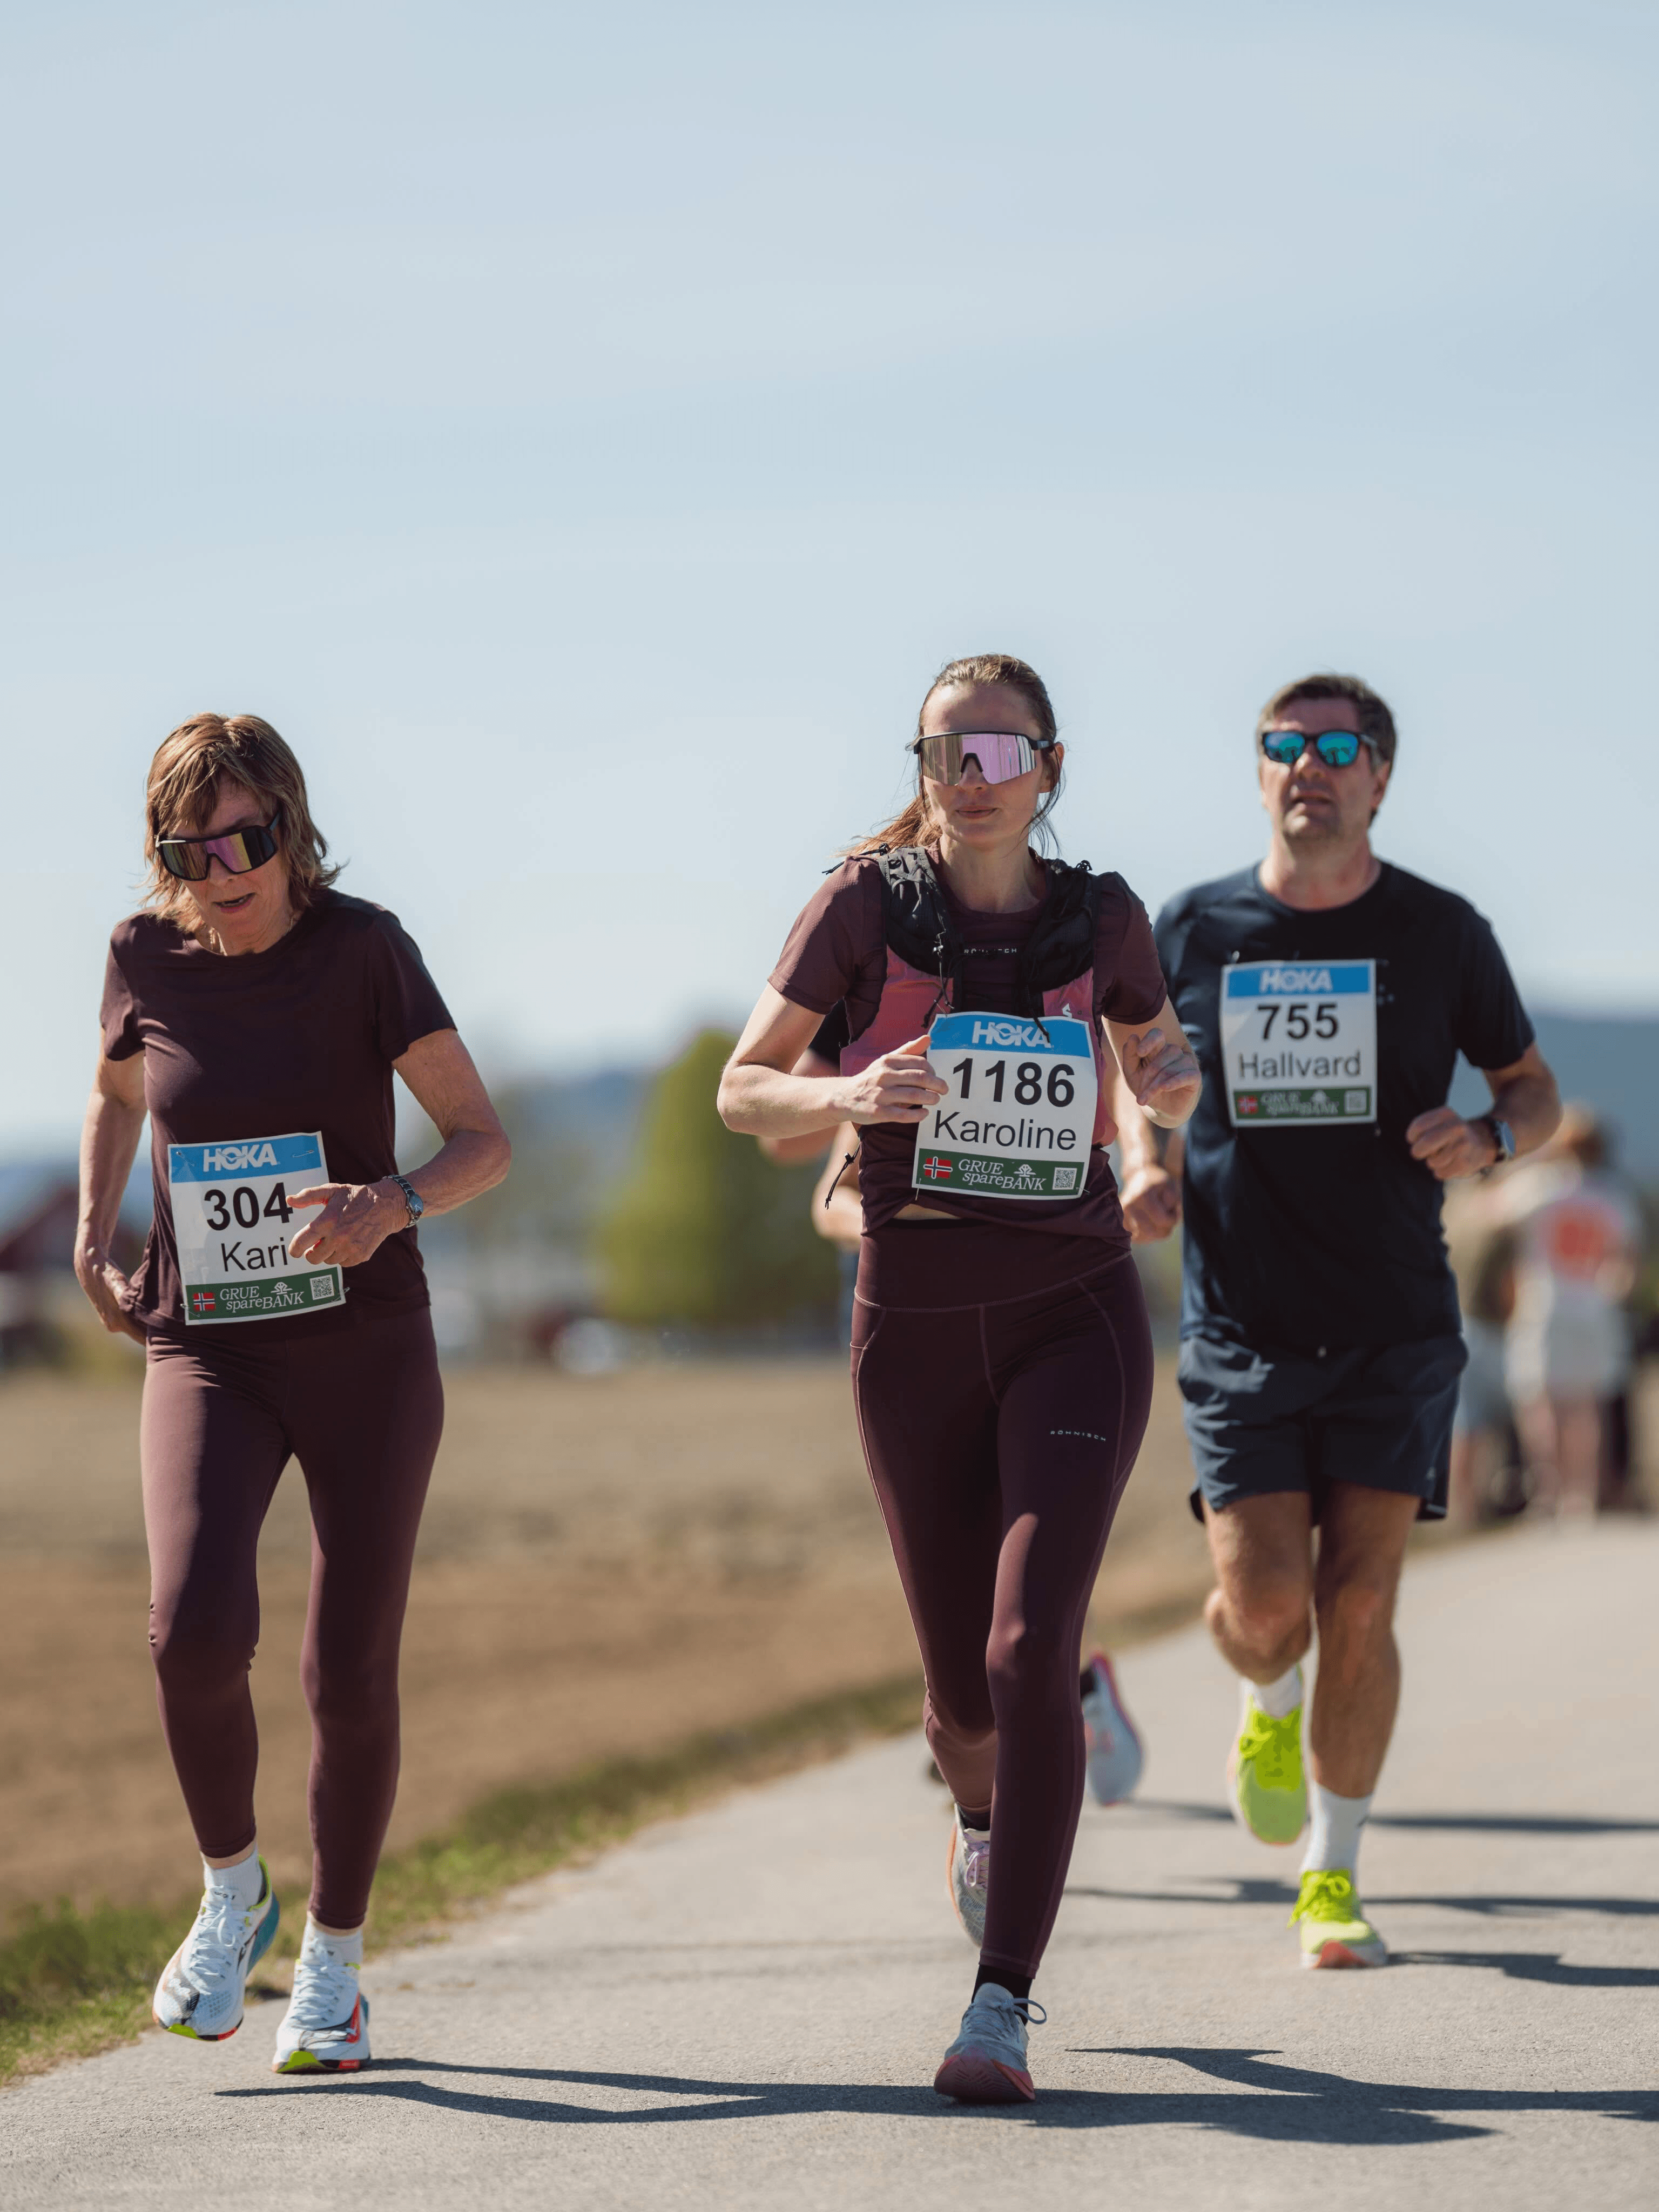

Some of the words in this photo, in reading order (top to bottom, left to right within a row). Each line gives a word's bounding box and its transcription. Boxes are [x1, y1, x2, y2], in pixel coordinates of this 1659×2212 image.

[1260, 969, 1333, 992] HOKA
[972, 1021, 1051, 1048] HOKA
[1257, 1002, 1339, 1040] 755
[1238, 1049, 1361, 1078] Hallvard
[953, 1057, 1075, 1108] 1186
[934, 1110, 1076, 1150] Karoline
[203, 1142, 278, 1172] HOKA
[958, 1158, 1004, 1175] GRUE
[962, 1172, 1047, 1191] spareBANK
[204, 1182, 293, 1231] 304
[221, 1237, 288, 1272] Kari
[219, 1286, 260, 1301] GRUE
[226, 1291, 305, 1313] spareBANK
[1050, 1429, 1106, 1441] RÖHNISCH
